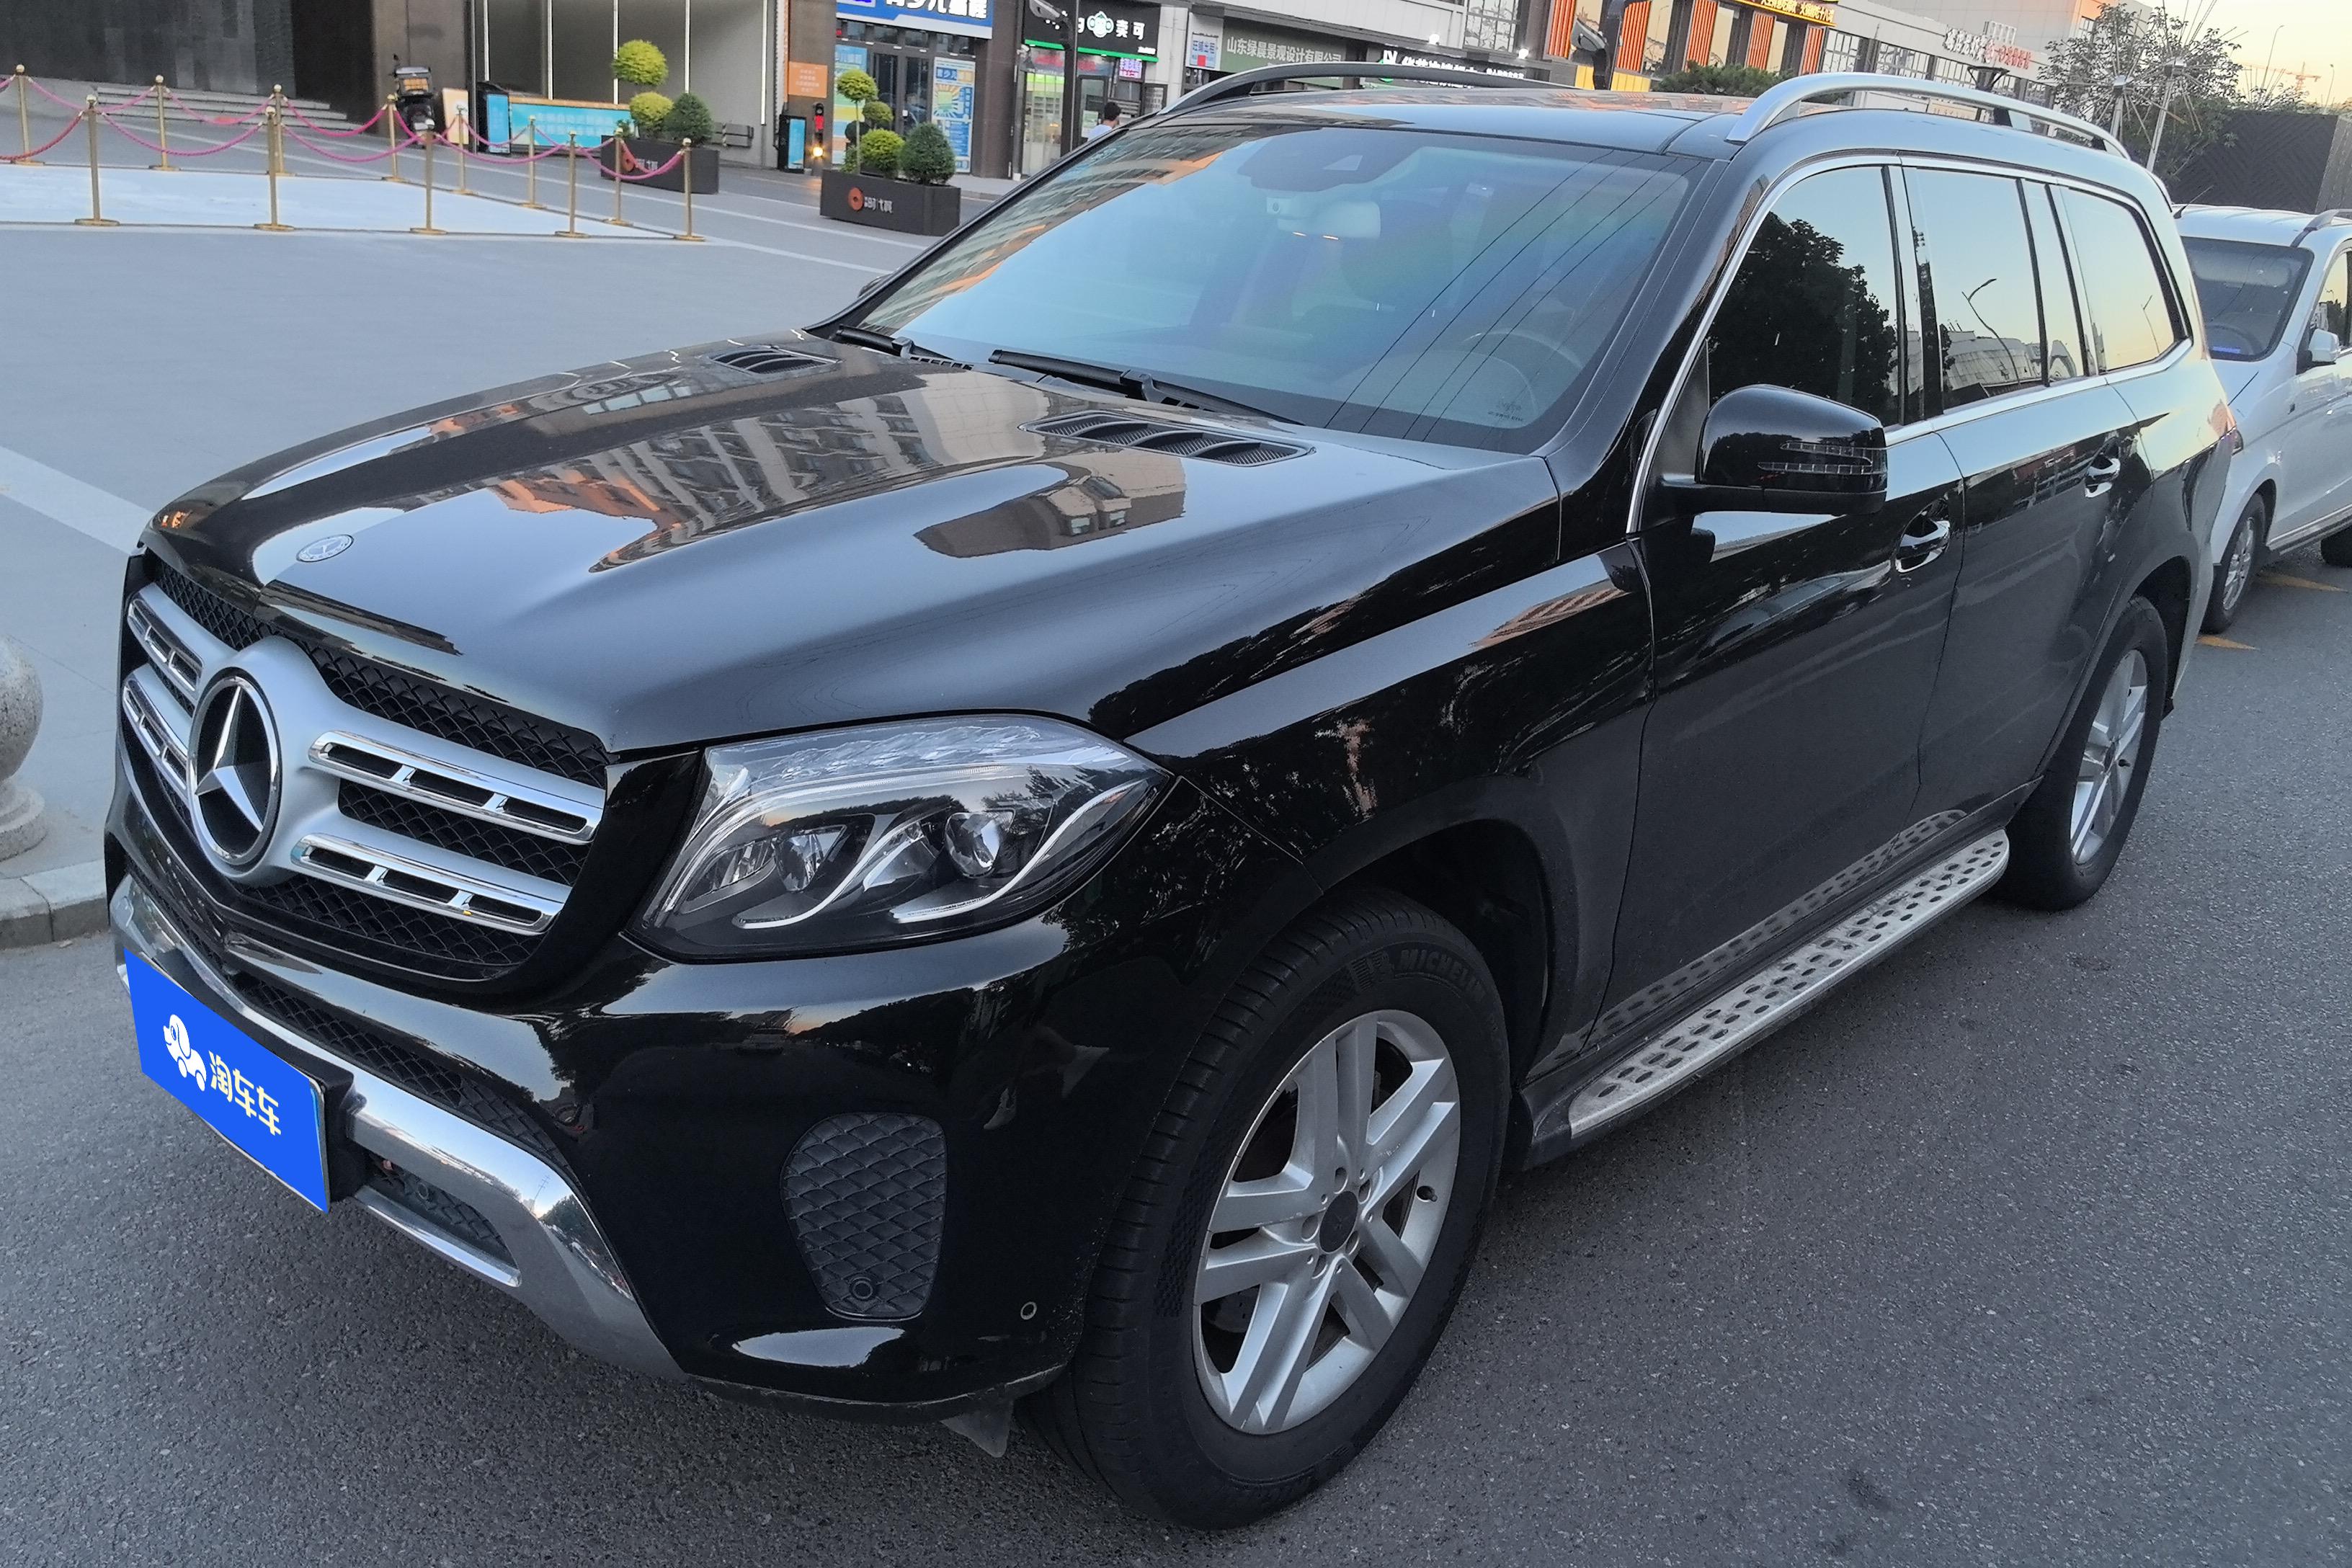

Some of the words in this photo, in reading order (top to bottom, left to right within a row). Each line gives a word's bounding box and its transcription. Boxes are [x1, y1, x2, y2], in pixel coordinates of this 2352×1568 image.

[1226, 36, 1342, 63] 山东绿晨景观设计有限公司
